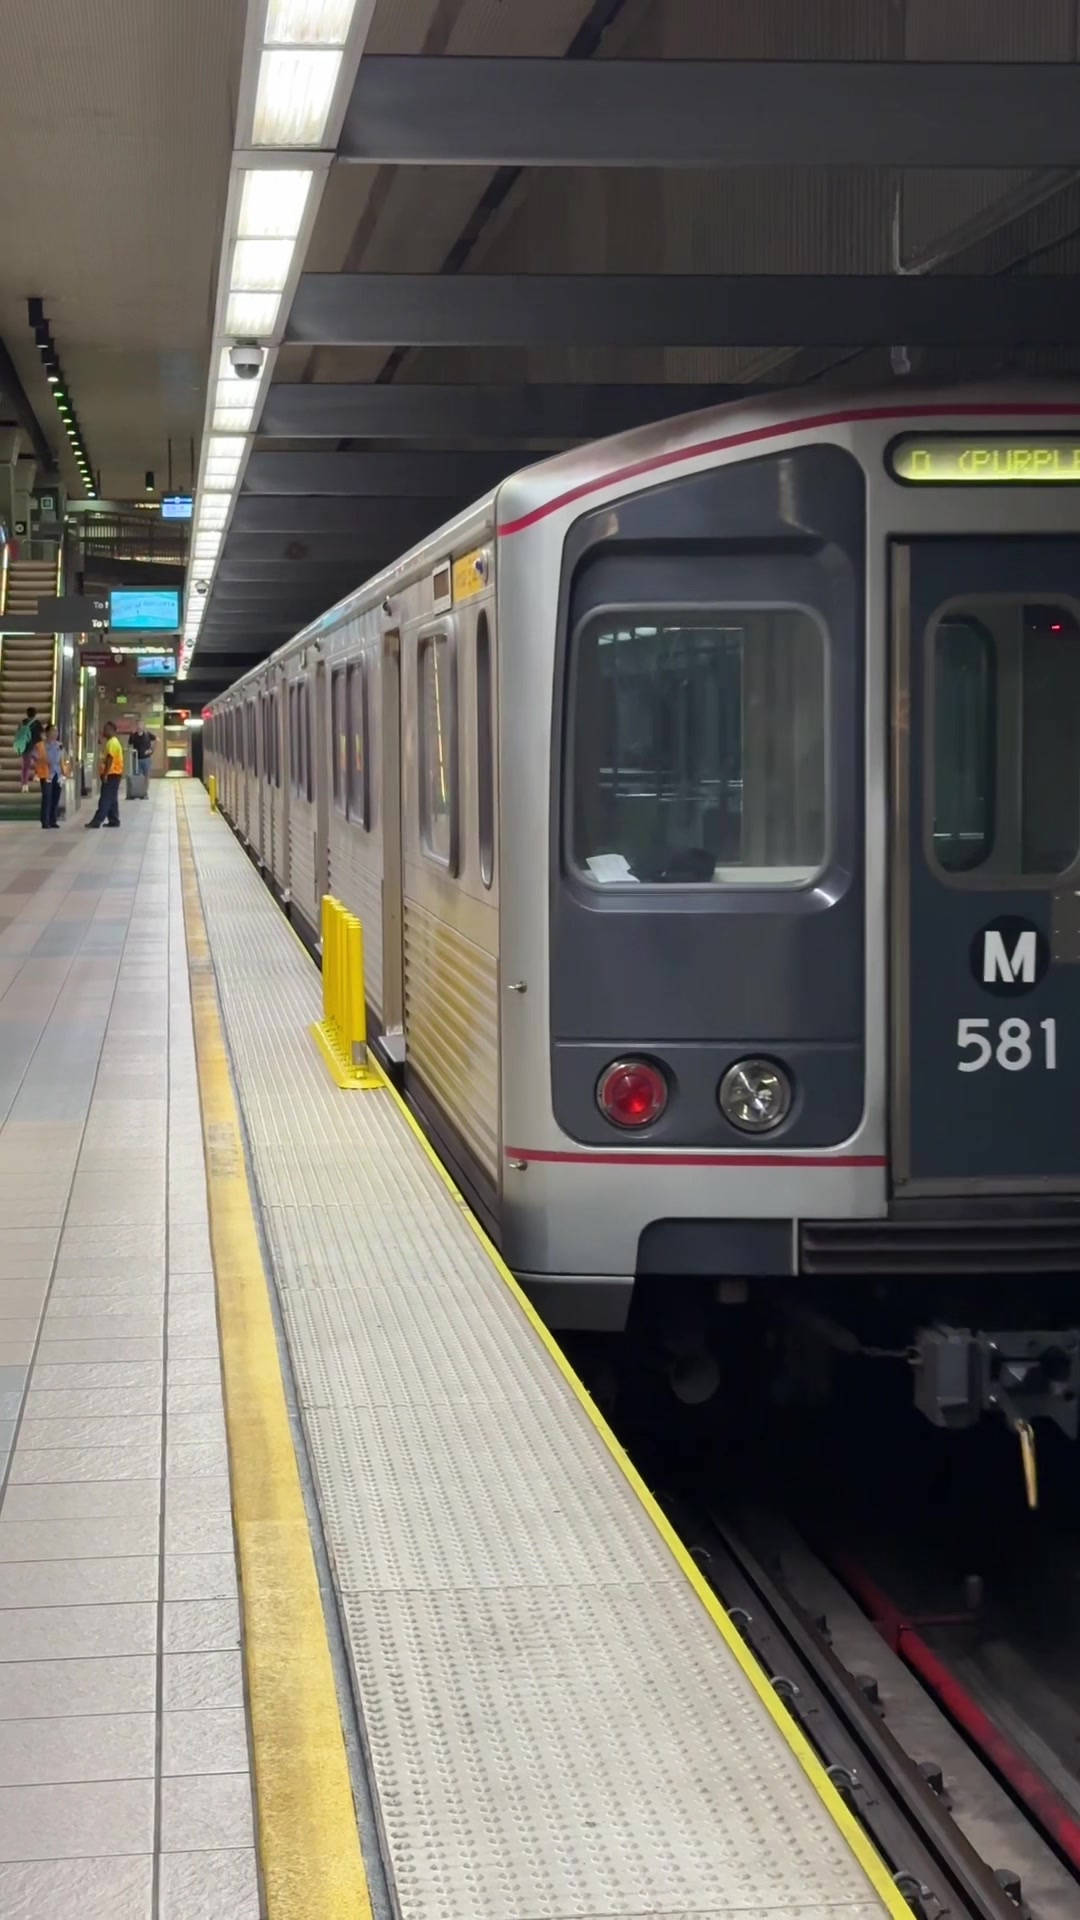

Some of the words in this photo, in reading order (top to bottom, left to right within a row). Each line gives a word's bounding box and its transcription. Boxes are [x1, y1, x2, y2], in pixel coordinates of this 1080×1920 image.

[93, 601, 104, 610] To
[92, 619, 103, 629] To
[983, 930, 1037, 983] M
[956, 1017, 1057, 1072] 581
